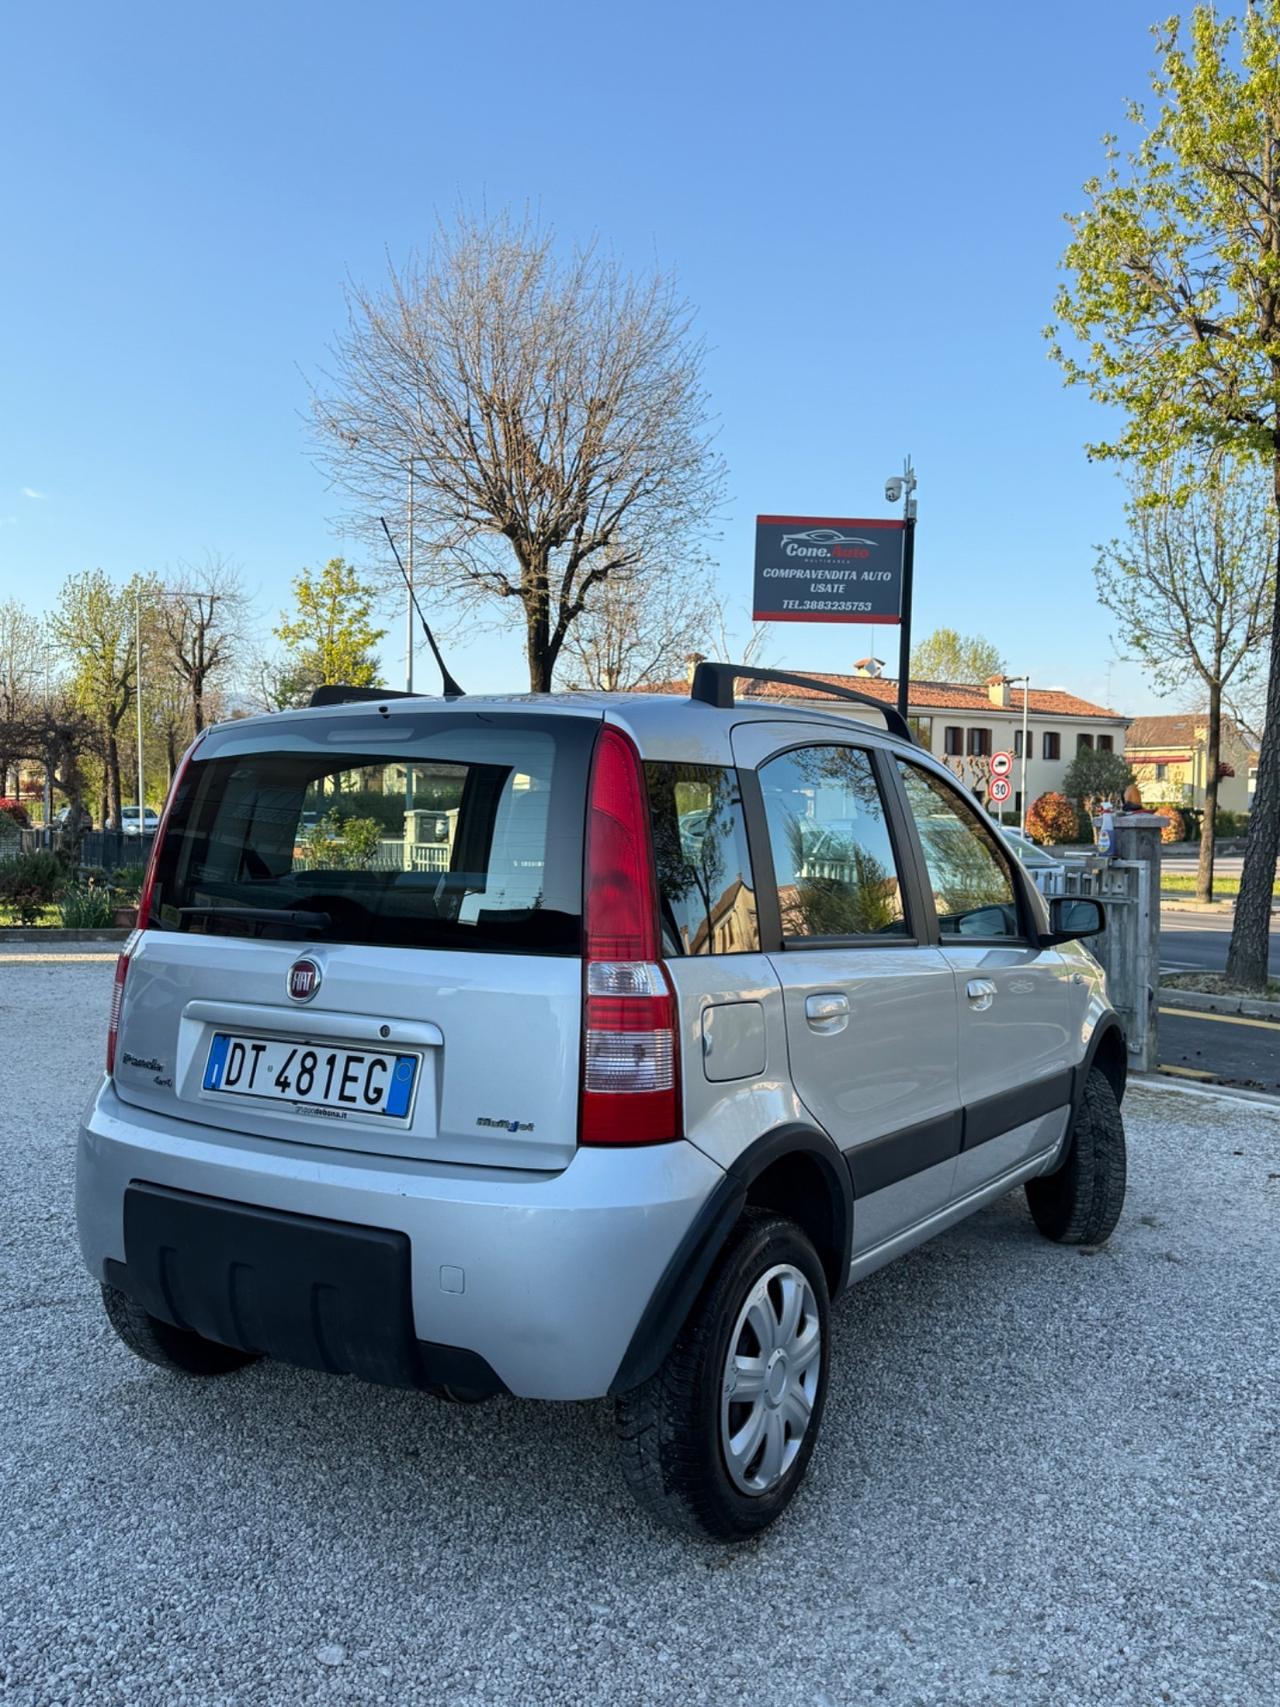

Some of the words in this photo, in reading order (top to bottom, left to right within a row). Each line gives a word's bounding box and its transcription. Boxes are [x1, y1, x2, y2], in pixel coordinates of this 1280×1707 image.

[763, 568, 857, 581] COMPRAVENDITA
[861, 571, 892, 582] AUTO
[810, 583, 846, 594] USATE
[782, 599, 872, 612] TEL.3883235753
[995, 783, 1006, 795] 30
